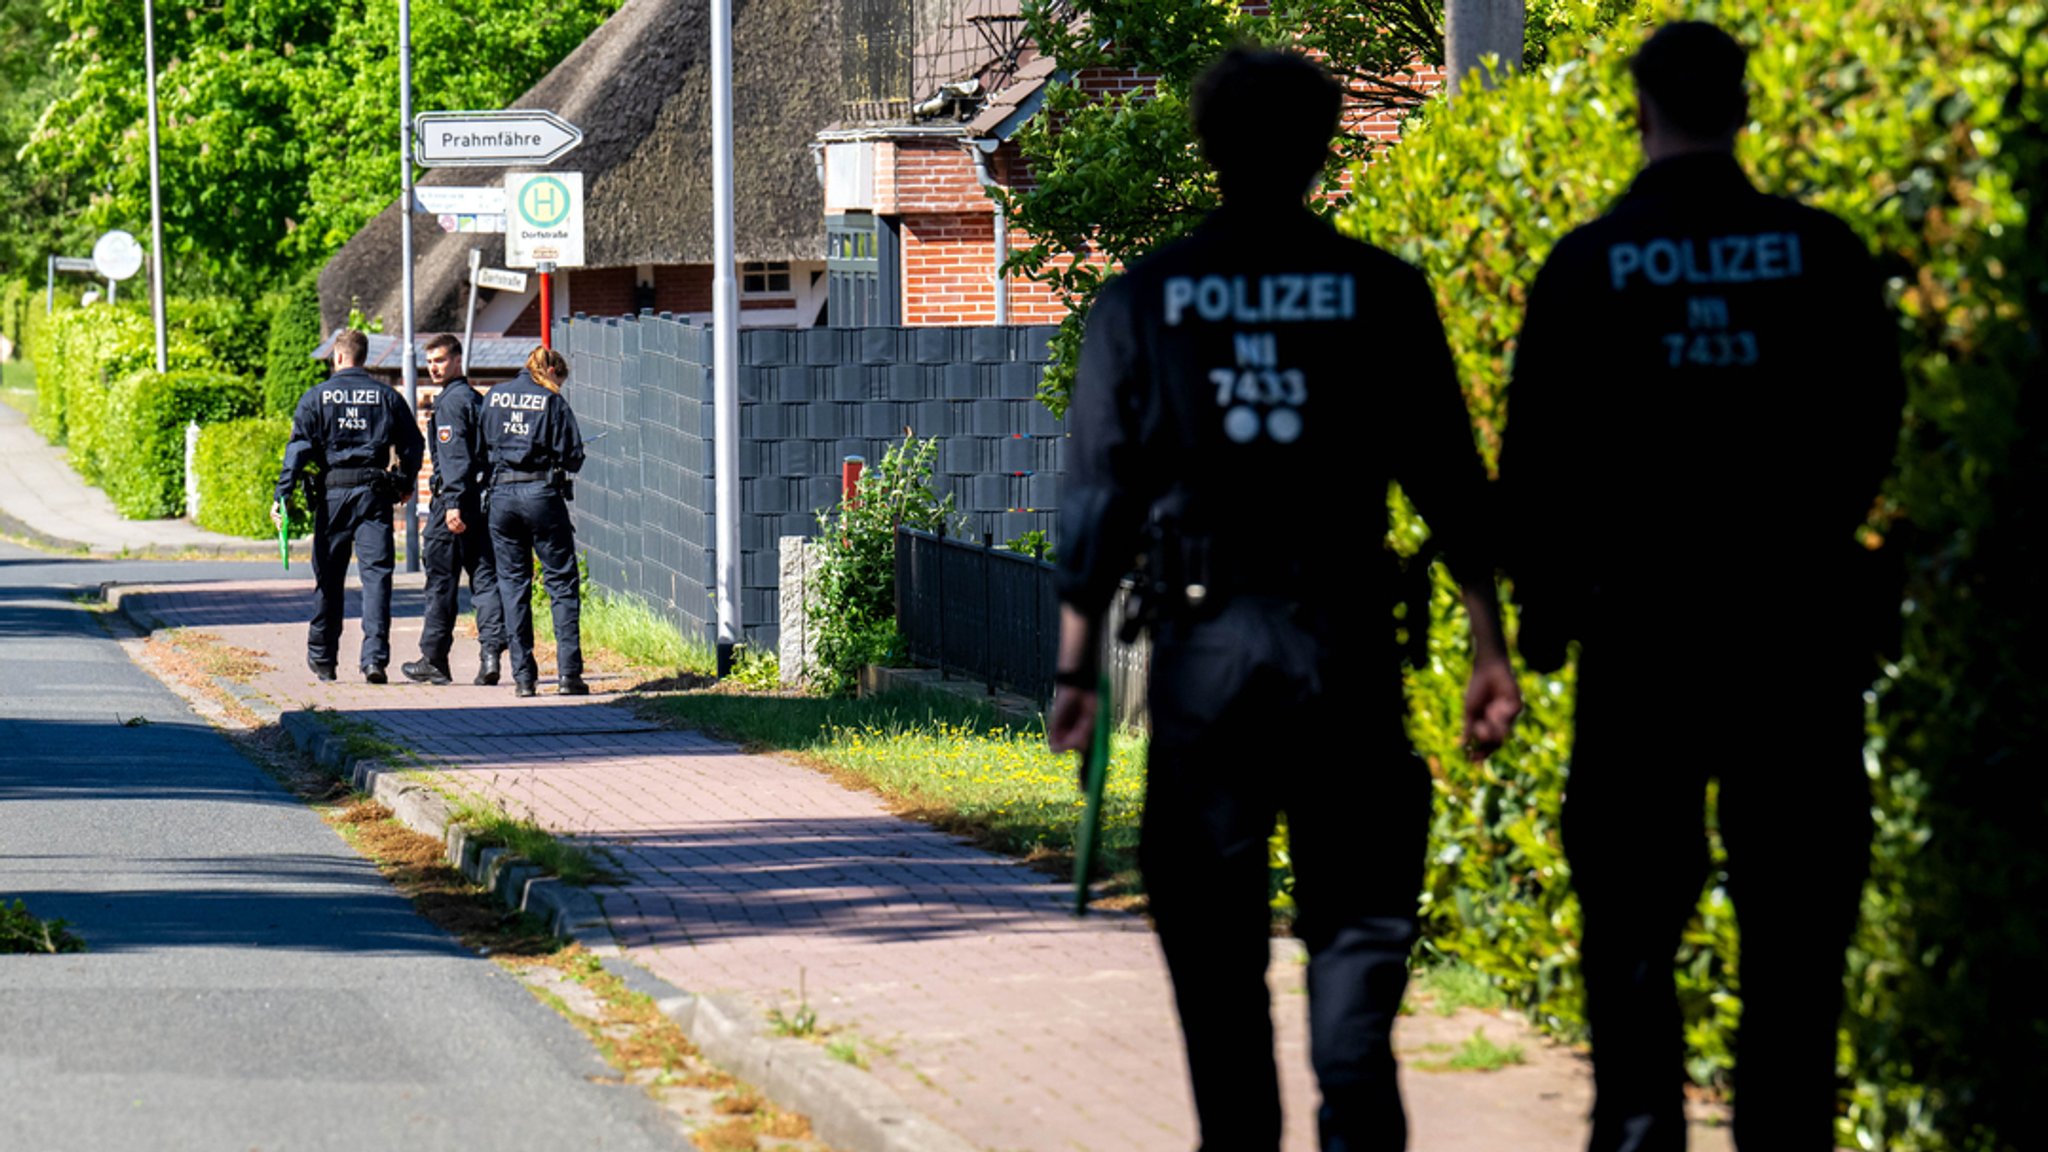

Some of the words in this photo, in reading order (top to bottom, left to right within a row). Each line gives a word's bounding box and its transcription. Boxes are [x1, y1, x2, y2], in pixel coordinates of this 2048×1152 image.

[442, 131, 542, 147] Prahmfähre
[533, 187, 554, 216] H
[521, 230, 569, 239] Dorfstraße
[1608, 231, 1802, 290] POLIZEI
[1164, 273, 1355, 326] POLIZEI
[1233, 331, 1277, 368] NI
[1662, 330, 1759, 368] 7433
[1208, 367, 1307, 407] 7433
[322, 390, 380, 405] POLIZEI
[490, 392, 547, 410] POLIZEI
[345, 407, 358, 418] NI
[510, 411, 523, 423] NI
[337, 417, 367, 431] 7433
[503, 422, 530, 436] 7433
